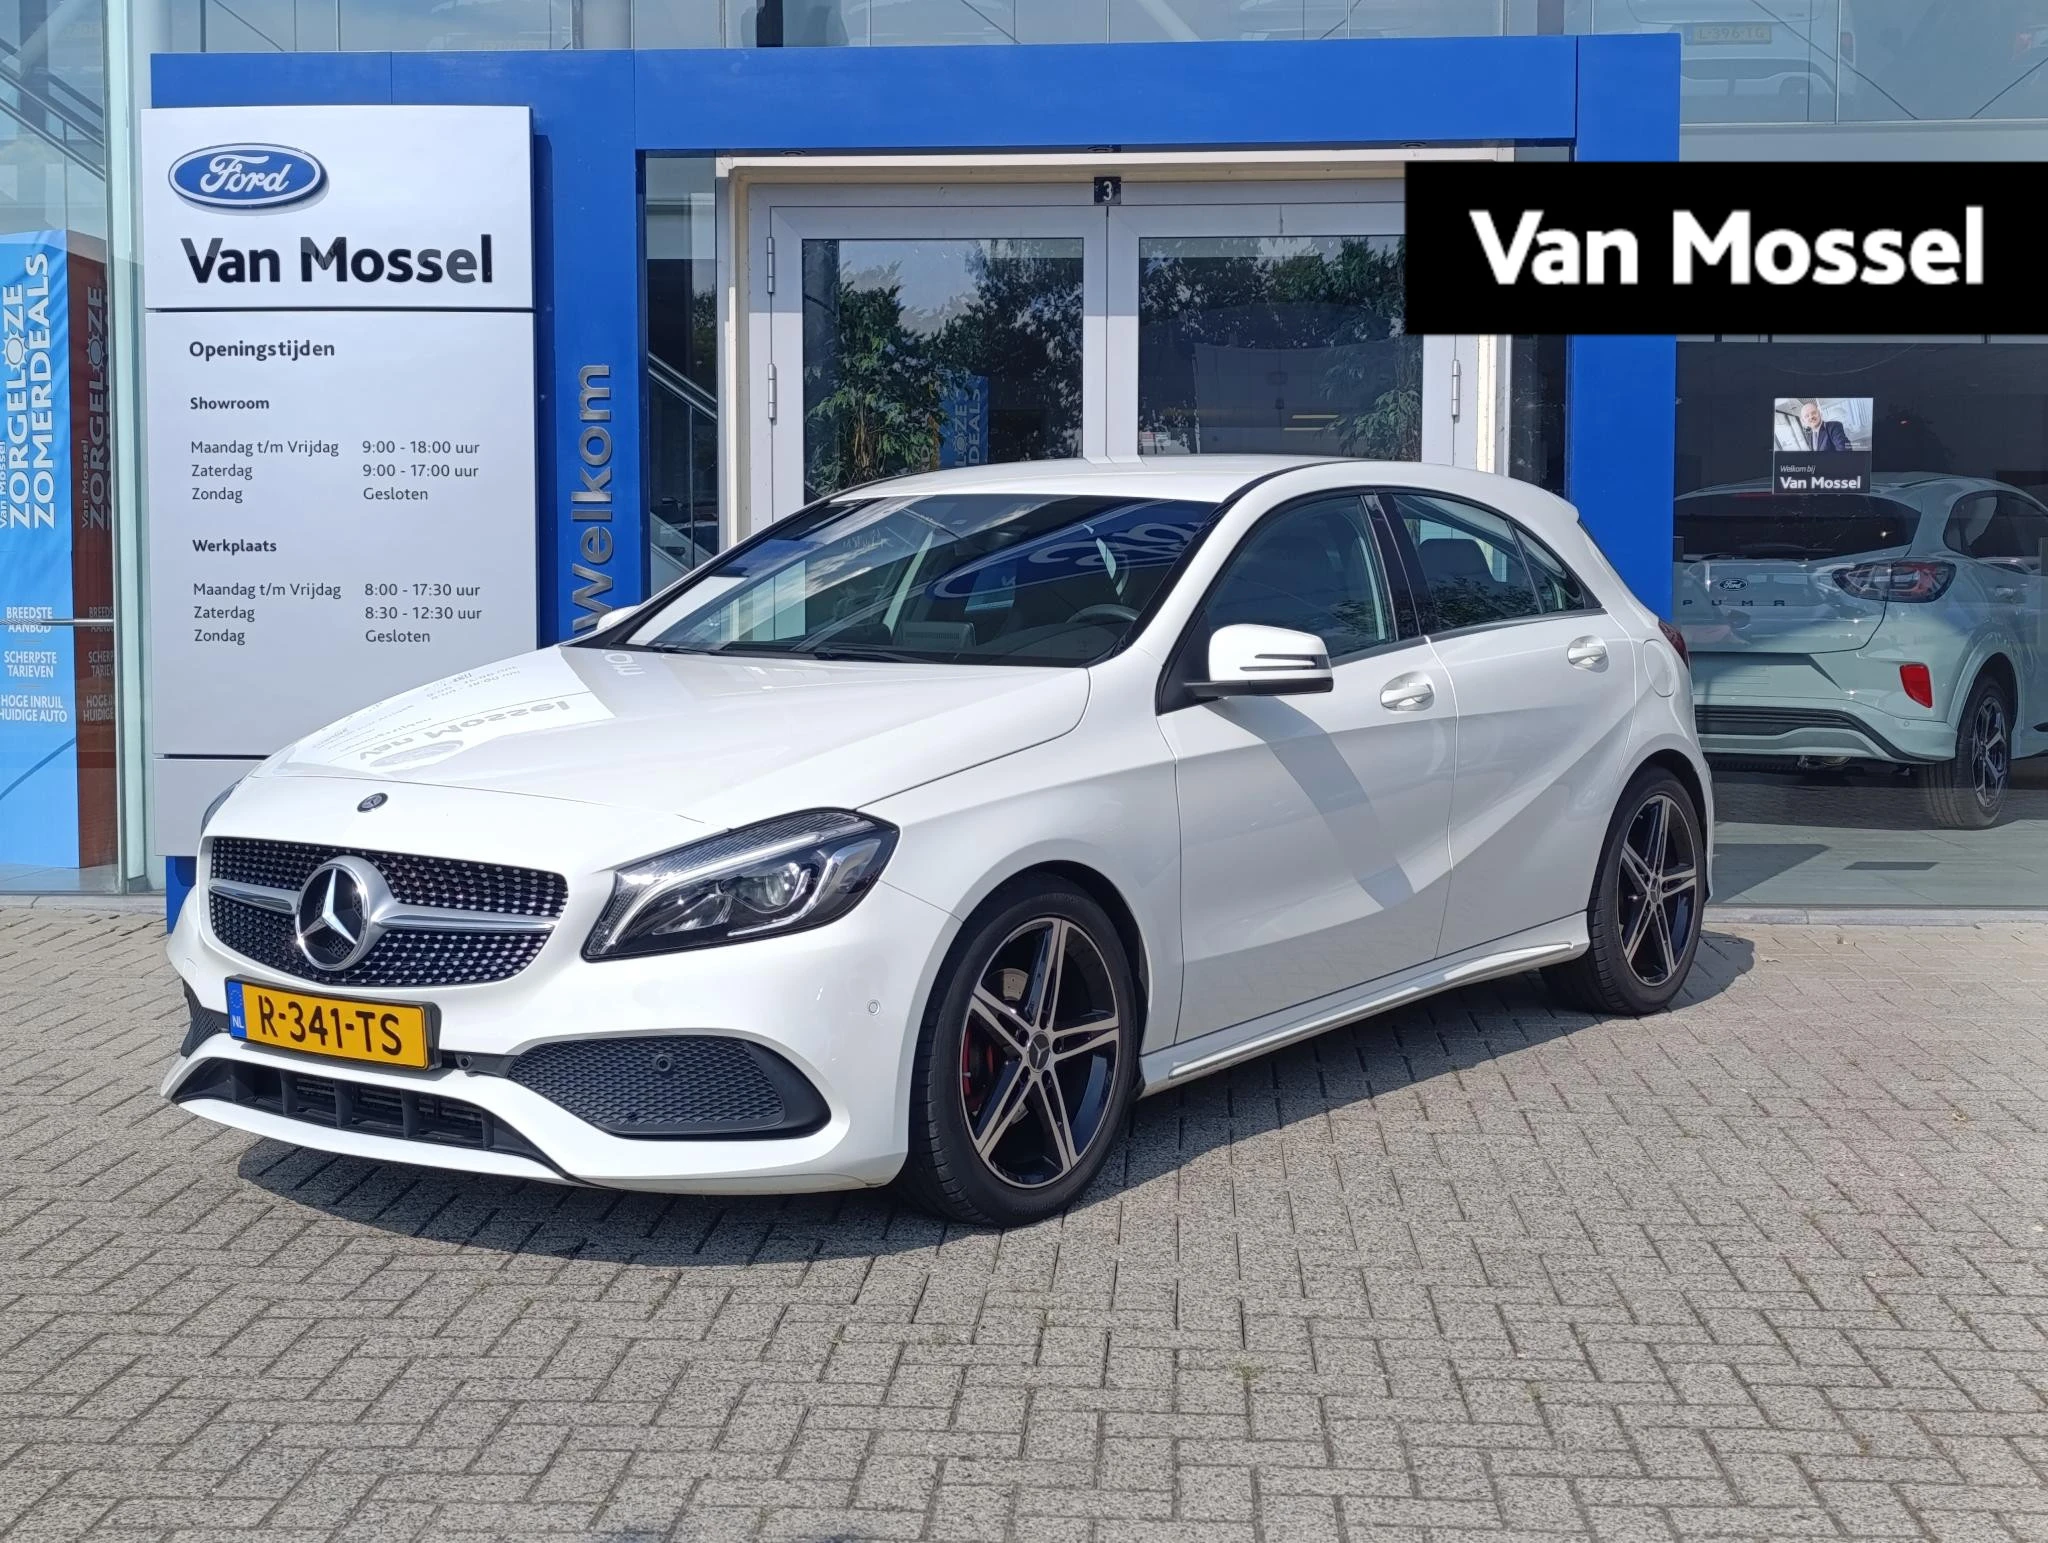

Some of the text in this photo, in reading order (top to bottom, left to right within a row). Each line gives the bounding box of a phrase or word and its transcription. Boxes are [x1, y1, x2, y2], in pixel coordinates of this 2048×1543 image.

[200, 154, 292, 193] Ford
[1101, 178, 1116, 202] 3
[180, 233, 493, 284] Van Mossel
[190, 340, 334, 362] Openingstijden
[26, 252, 55, 529] ZOMERDEALS
[191, 397, 269, 409] Showroom
[192, 440, 253, 457] Maandag
[257, 440, 283, 453] t/m
[288, 440, 339, 457] Vrijdag
[363, 441, 395, 453] 9:00
[410, 441, 450, 453] 18:00
[456, 445, 480, 453] uur
[192, 464, 252, 480] Zaterdag
[363, 464, 395, 476] 9:00
[411, 464, 449, 476] 17:00
[455, 468, 478, 477] uur
[1780, 464, 1816, 476] Welkom bij
[1780, 475, 1861, 490] Van Mossel
[192, 487, 428, 503] Zondag Gesloten
[571, 364, 614, 633] Welkom
[192, 539, 276, 555] Werkplaats
[194, 583, 256, 599] Maandag
[259, 583, 285, 596] t/m
[290, 583, 341, 599] Vrijdag
[365, 584, 397, 595] 8:00
[413, 584, 451, 596] 17:30
[457, 587, 480, 596] uur
[6, 606, 53, 619] BREEDSTE
[194, 606, 254, 622] Zaterdag
[365, 607, 397, 619] 8:30
[413, 607, 453, 619] 12:30
[458, 610, 482, 619] uur
[195, 629, 430, 645] Zondag Gesloten
[4, 651, 57, 664] SCHERPSTE
[7, 665, 54, 678] TARIEVEN
[1, 694, 63, 709] HOGE INRUIL
[39, 710, 67, 723] AUTO
[231, 1015, 245, 1029] NL
[259, 995, 402, 1056] R-341-TS
